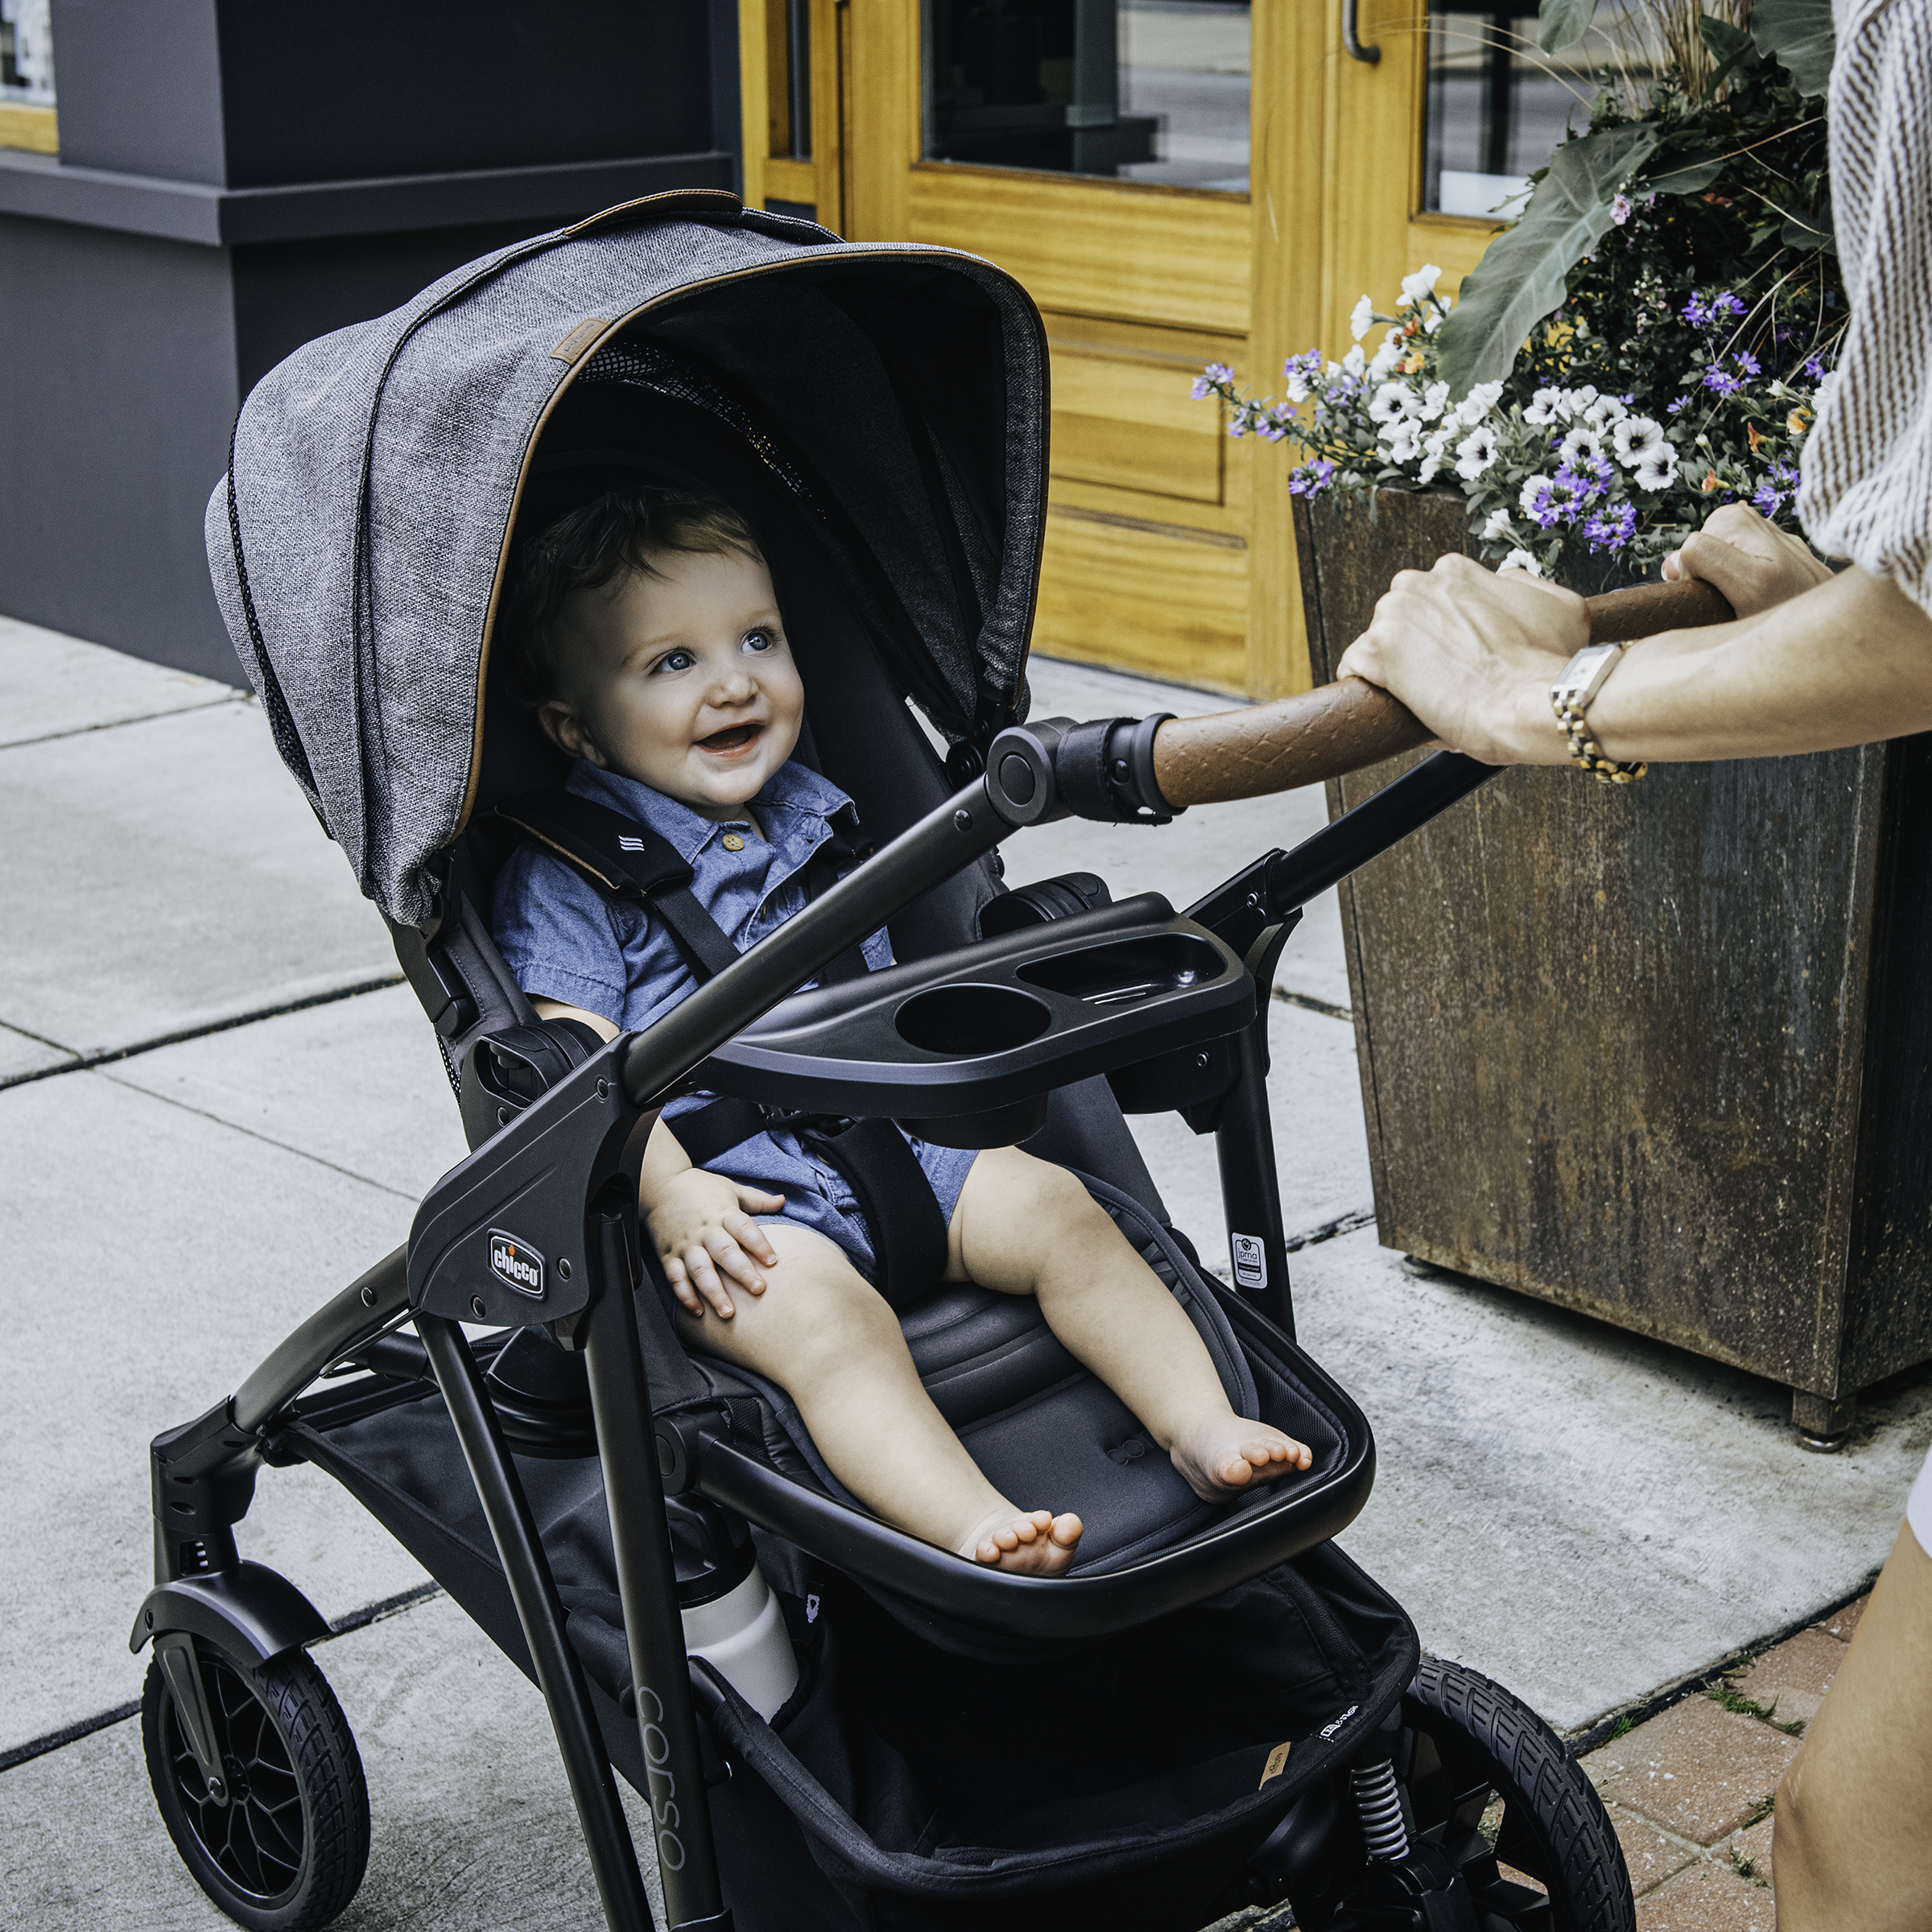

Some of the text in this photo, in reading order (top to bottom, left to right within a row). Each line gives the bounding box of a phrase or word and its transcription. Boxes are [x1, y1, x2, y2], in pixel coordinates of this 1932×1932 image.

[493, 1245, 539, 1287] chicco
[1237, 1248, 1257, 1260] jpma
[637, 1686, 685, 1871] corso
